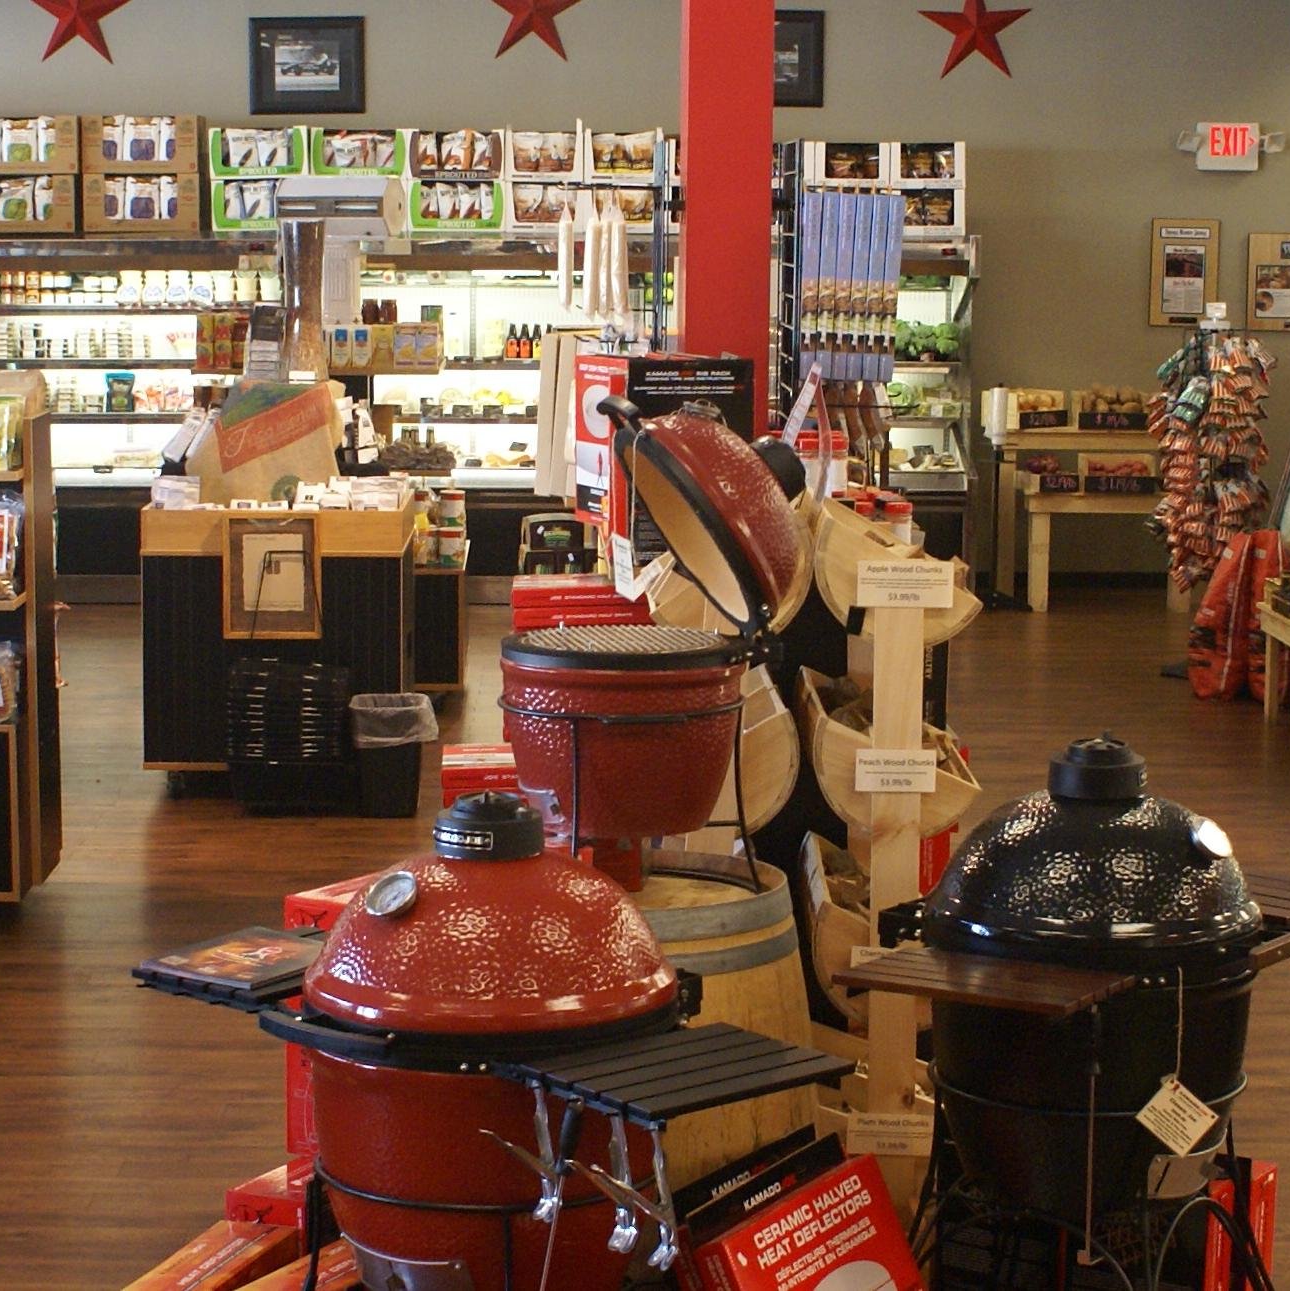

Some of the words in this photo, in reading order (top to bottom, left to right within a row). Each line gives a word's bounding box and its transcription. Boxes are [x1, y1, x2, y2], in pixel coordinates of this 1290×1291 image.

[1211, 127, 1249, 156] EXIT
[239, 167, 278, 176] SPROUTED
[340, 167, 379, 177] SPROUTED
[434, 170, 478, 179] SPROUTED
[867, 564, 889, 574] Apple
[890, 564, 914, 574] Wood
[915, 564, 943, 574] Chunks
[858, 758, 882, 767] Peach
[883, 758, 907, 767] Wood
[907, 758, 935, 767] Chunks
[878, 1118, 901, 1128] Wood
[901, 1118, 929, 1128] Chunks
[710, 1170, 752, 1200] KAMADO
[742, 1181, 782, 1212] KAMADO
[752, 1203, 814, 1251] CERAMIC
[812, 1174, 863, 1214] HALVED
[756, 1237, 793, 1271] HEAT
[792, 1188, 873, 1249] DEFLECTORS
[824, 1250, 837, 1267] EN
